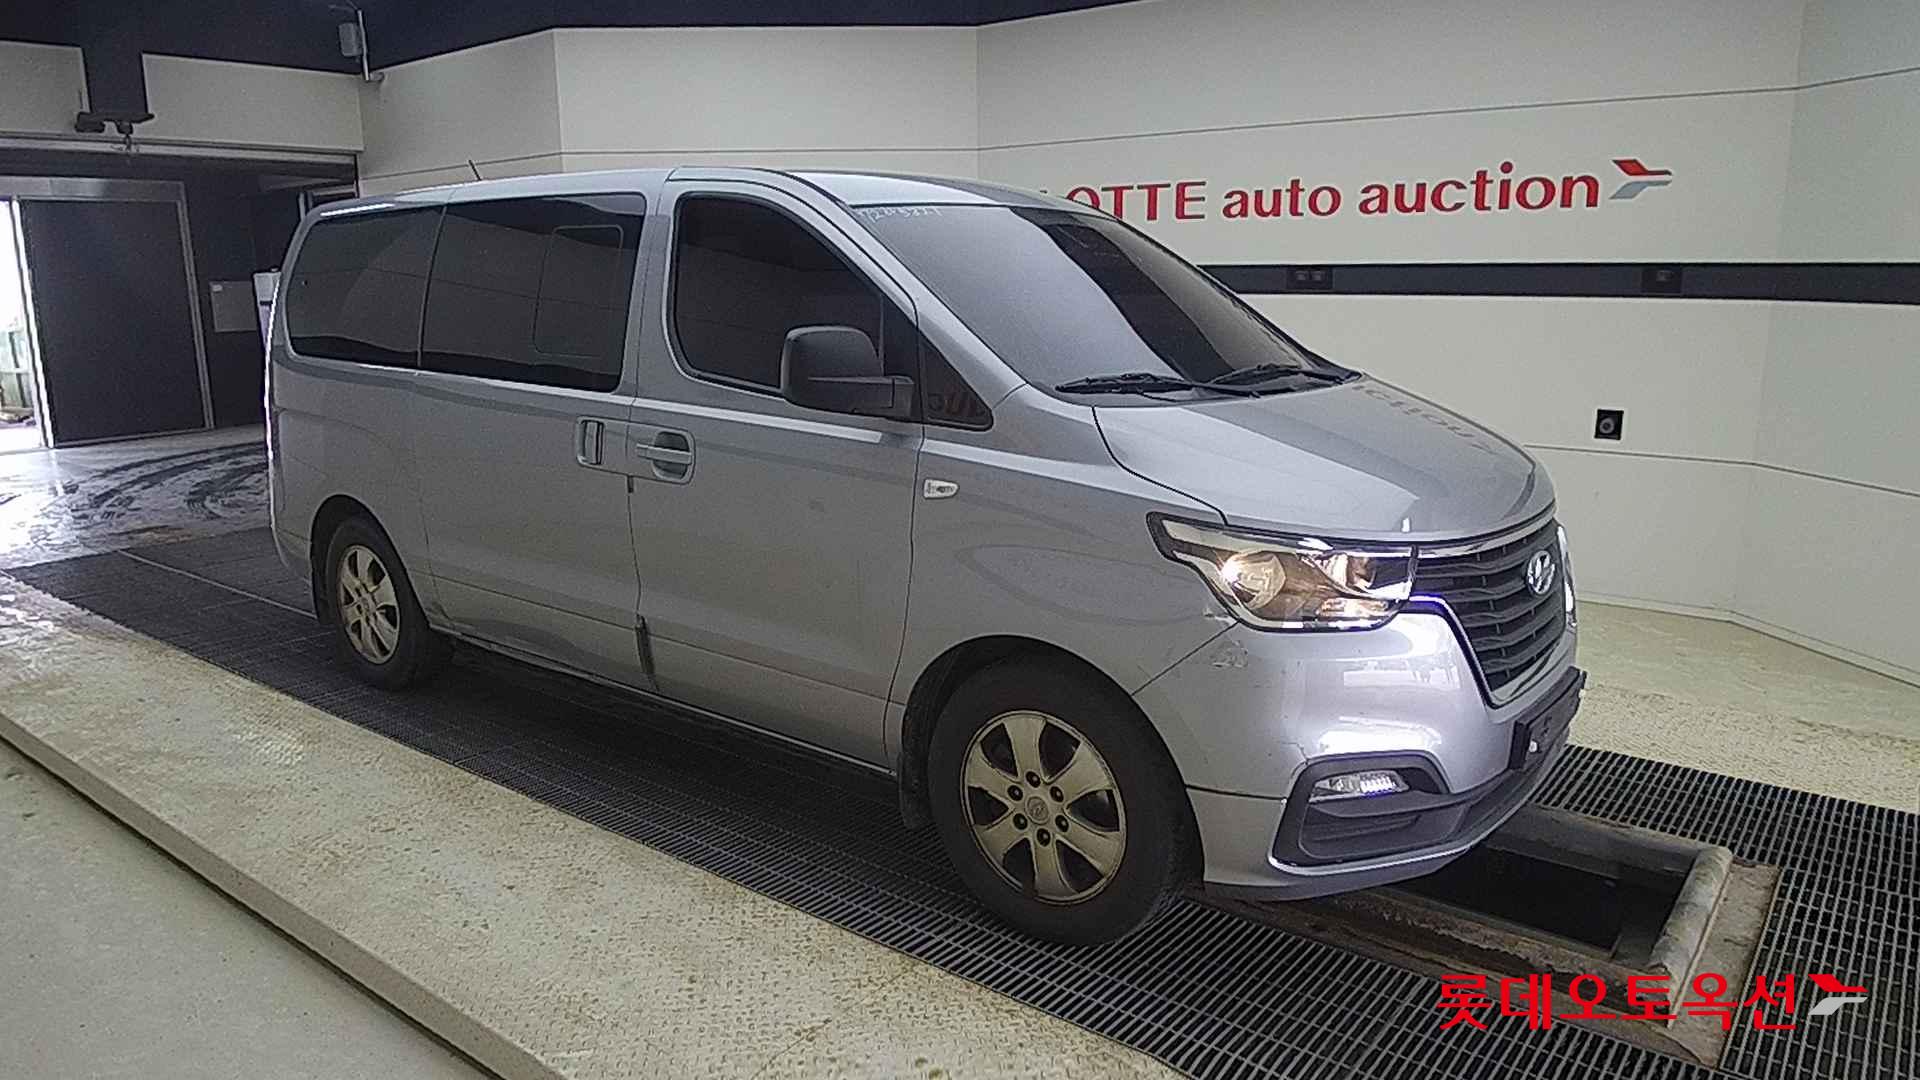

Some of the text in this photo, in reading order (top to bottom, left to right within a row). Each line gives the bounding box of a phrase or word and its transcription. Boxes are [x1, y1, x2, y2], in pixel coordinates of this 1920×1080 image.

[1040, 161, 1600, 221] OTTE auto auction
